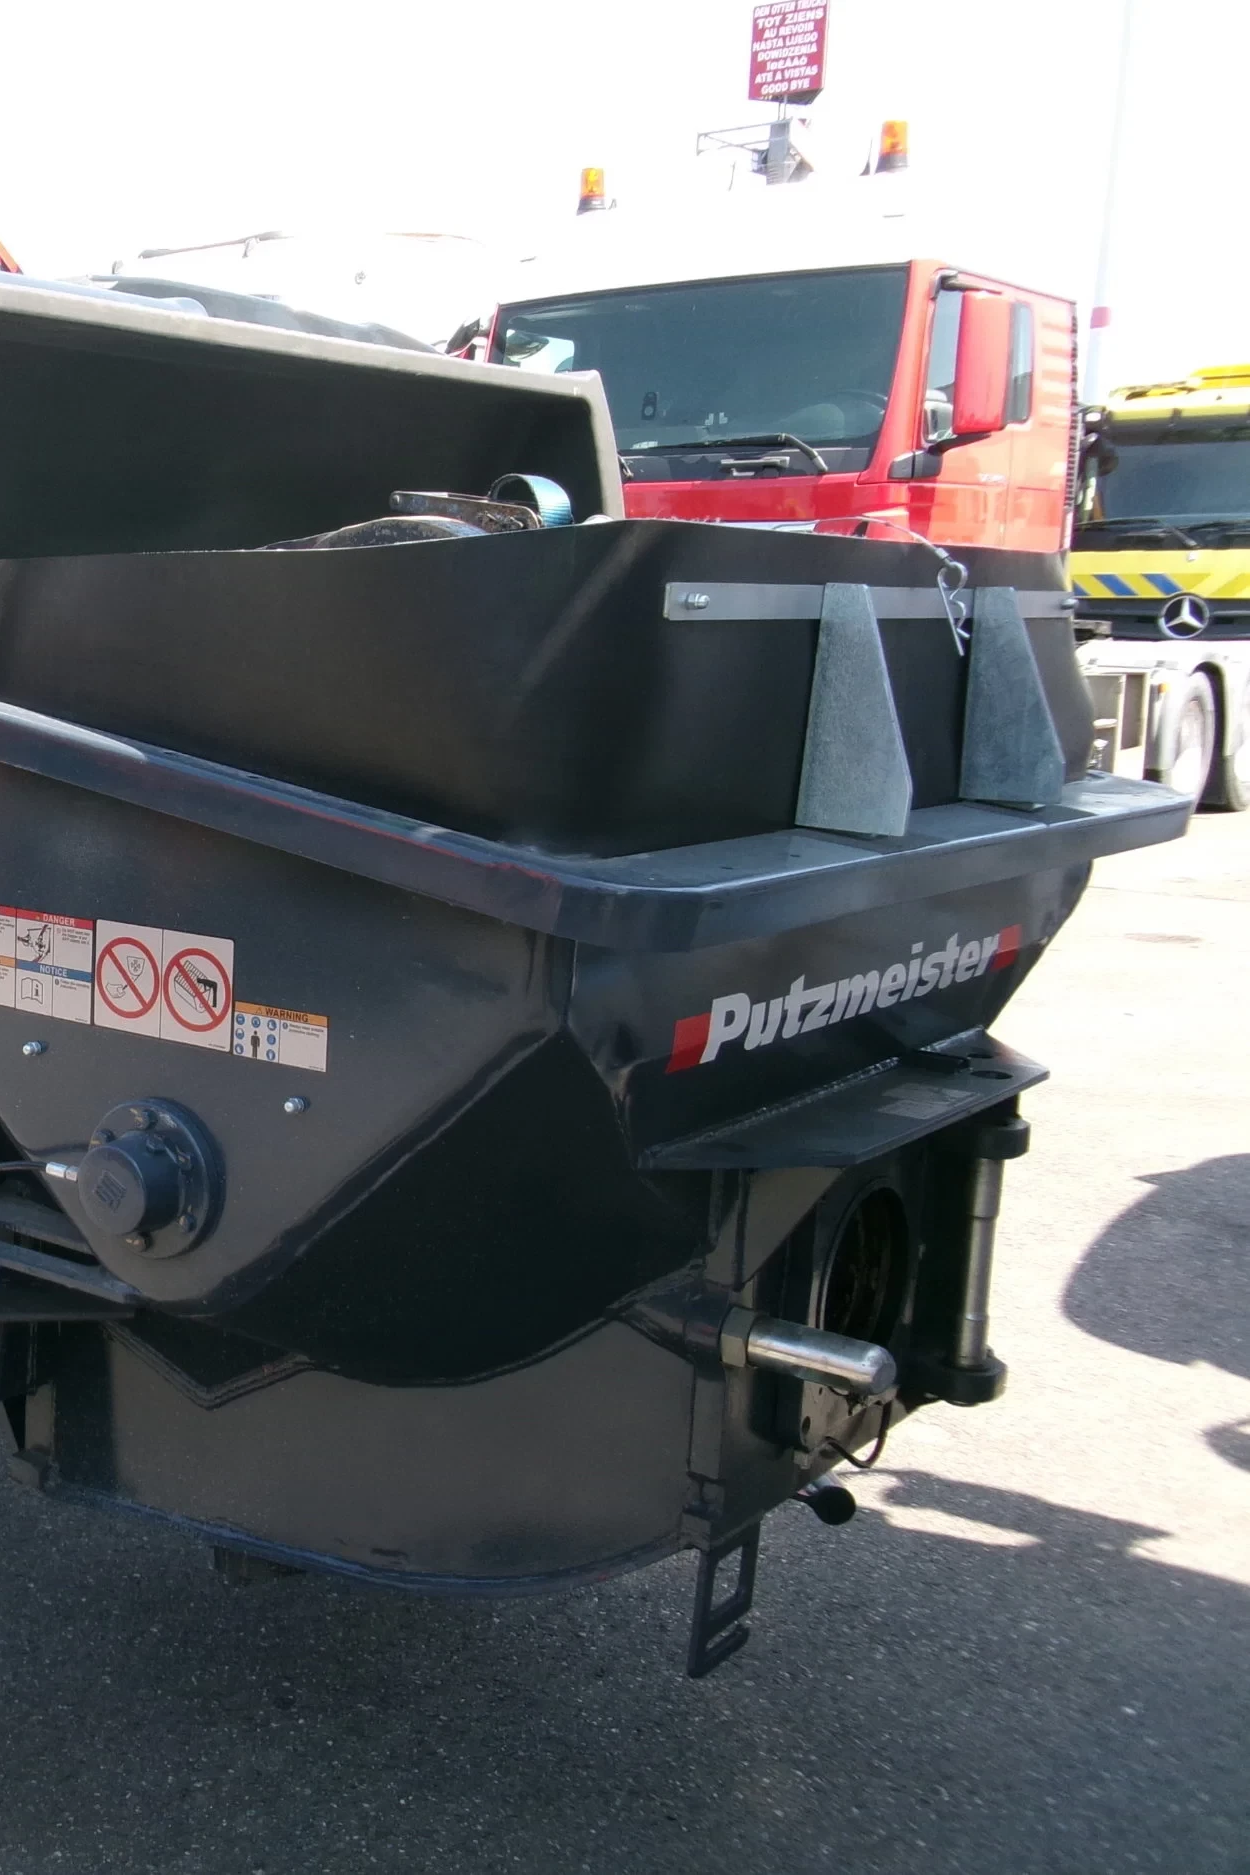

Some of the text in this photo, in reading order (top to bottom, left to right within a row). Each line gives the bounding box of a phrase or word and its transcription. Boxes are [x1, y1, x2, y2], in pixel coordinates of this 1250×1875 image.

[756, 8, 824, 30] TOT ZIENS
[763, 21, 815, 39] AU REVOIR
[753, 32, 818, 52] HASTA LUEGO
[775, 70, 783, 81] A
[761, 78, 811, 95] GOOD BYE
[42, 913, 75, 927] DANGER
[39, 964, 68, 977] NOTICE
[700, 932, 1000, 1064] Putzmeister
[265, 1007, 309, 1023] WARNING
